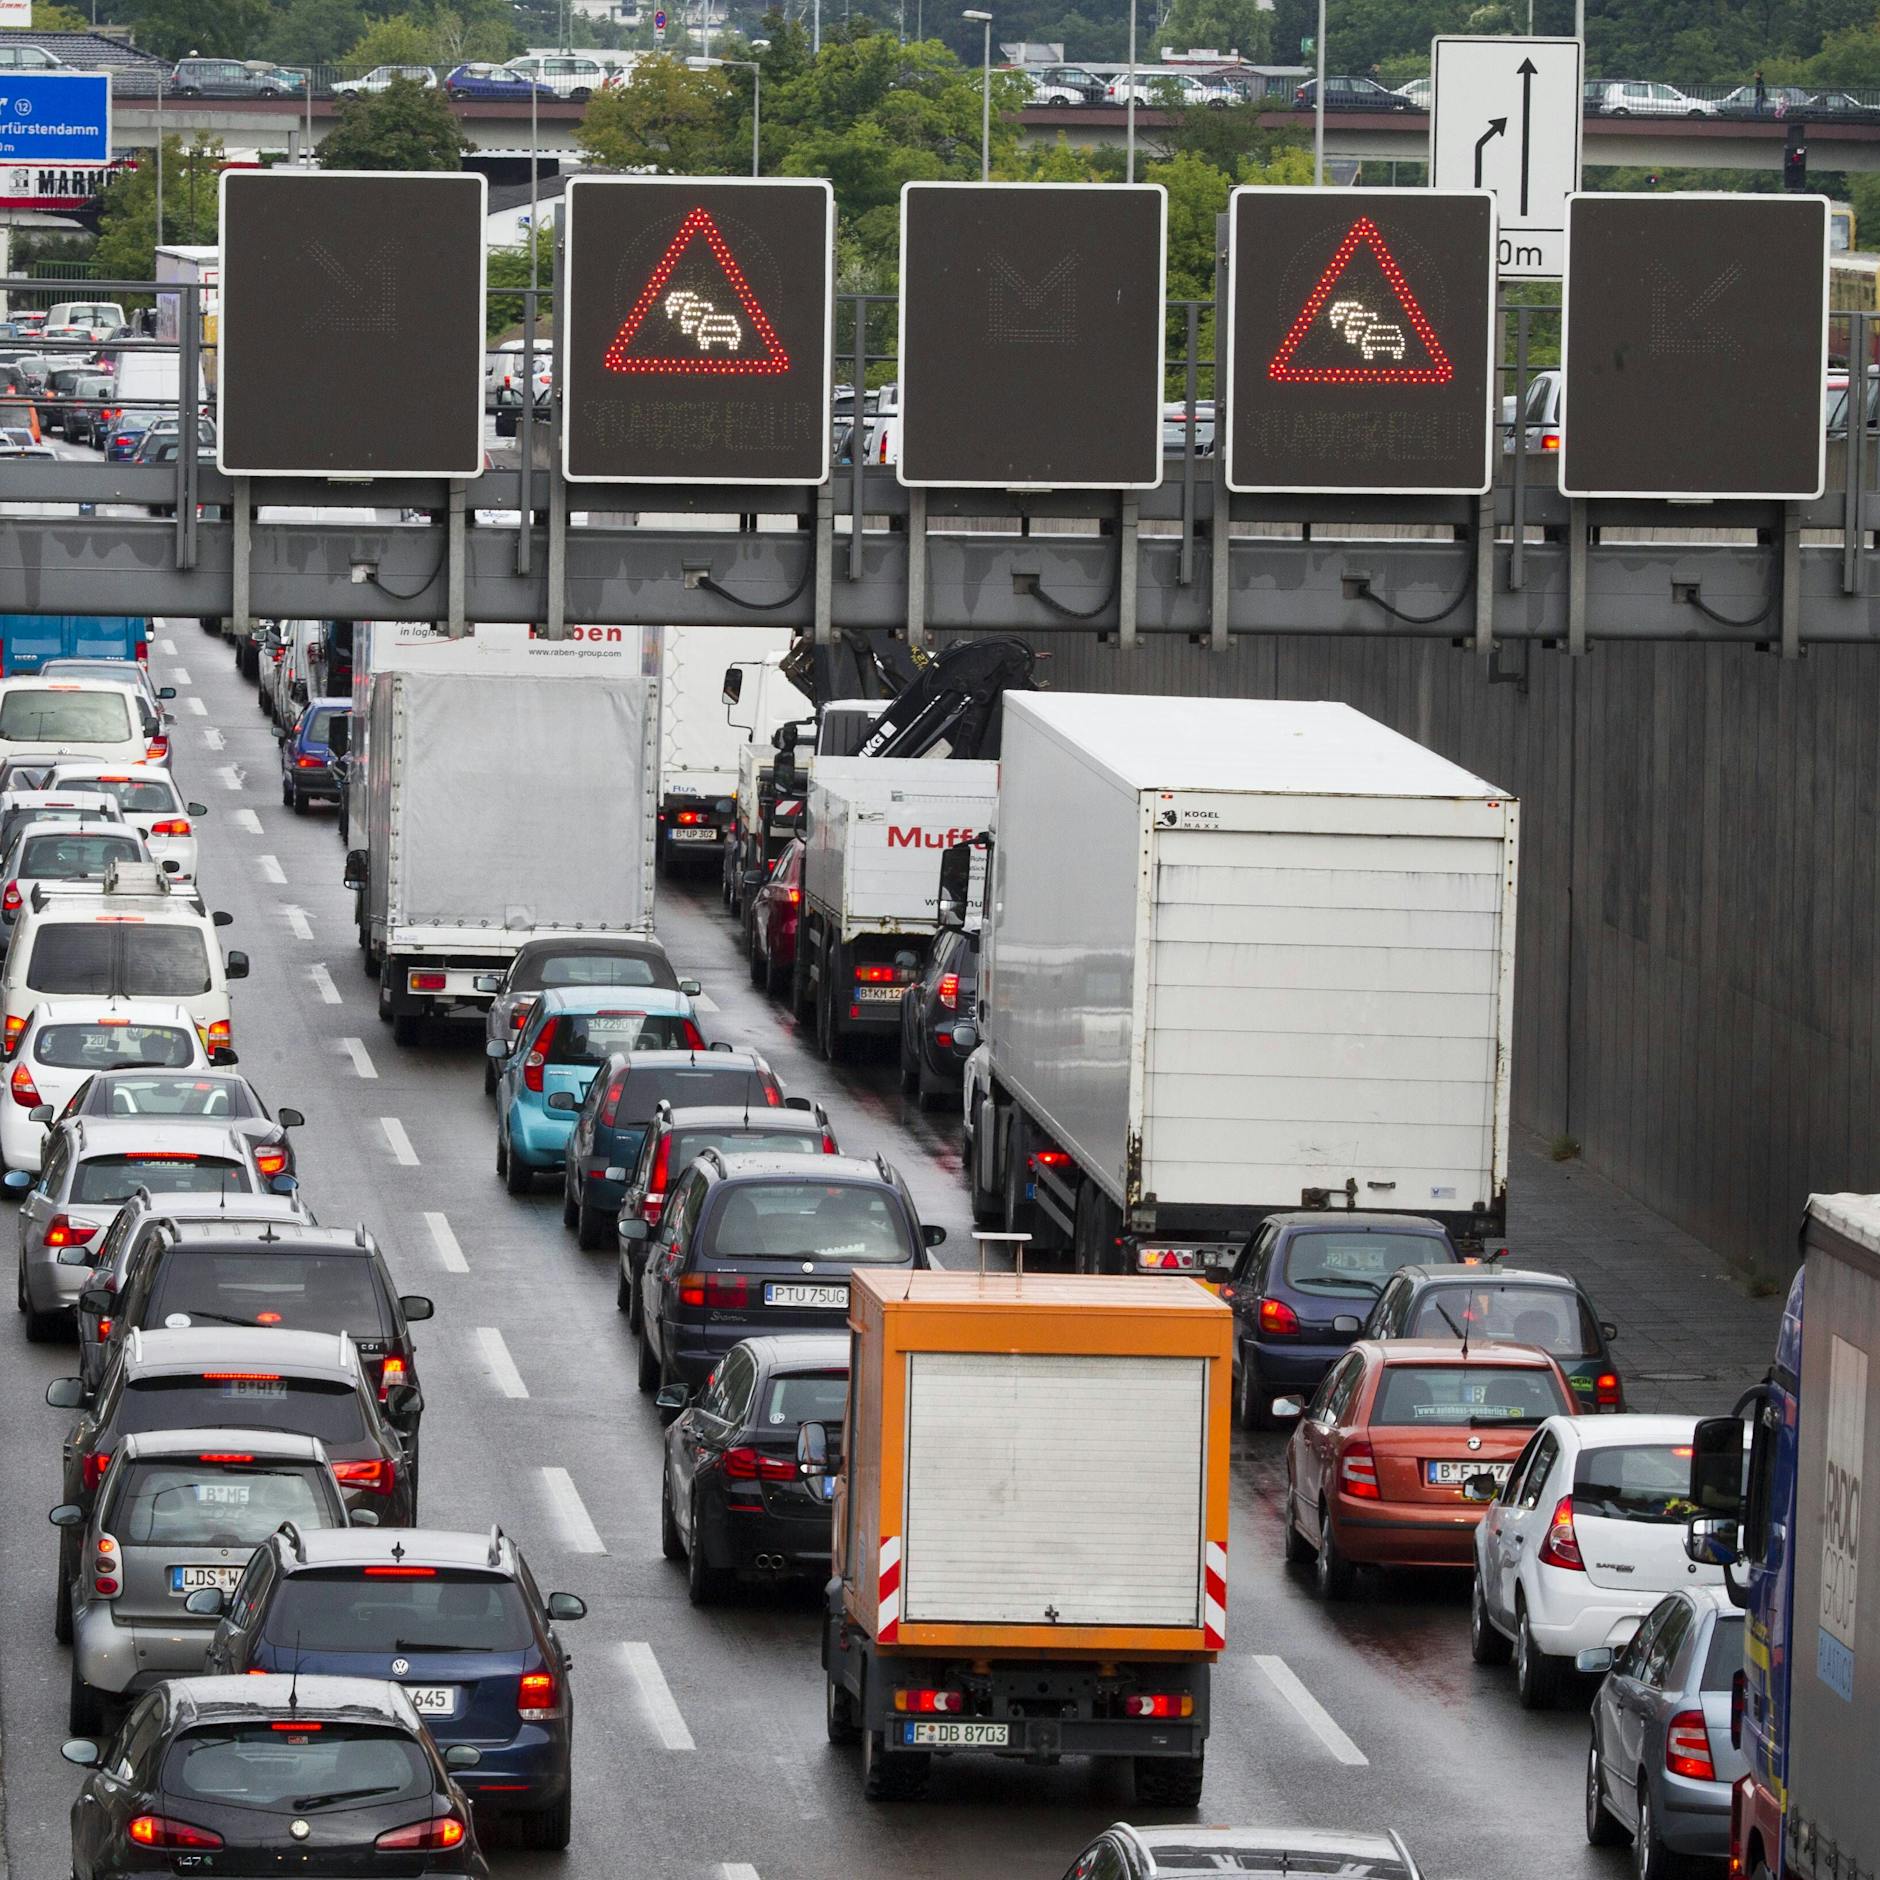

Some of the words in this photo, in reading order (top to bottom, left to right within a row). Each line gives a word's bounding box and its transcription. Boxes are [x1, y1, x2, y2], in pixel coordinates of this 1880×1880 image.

[18, 102, 29, 112] 12
[0, 122, 99, 136] rfürstendamm
[38, 169, 112, 195] MARM
[411, 626, 438, 639] logis
[528, 623, 622, 642] ben
[528, 648, 622, 658] www.raben-group.com
[888, 989, 902, 999] 12
[774, 1287, 806, 1302] PTU
[809, 1288, 846, 1304] 75UG
[1440, 1464, 1450, 1479] B
[184, 1570, 217, 1586] LDS
[228, 1570, 240, 1586] W
[413, 1690, 446, 1708] 645
[915, 1725, 927, 1741] F
[938, 1725, 960, 1742] DB
[964, 1725, 1006, 1743] 8703
[177, 1856, 202, 1867] 147
